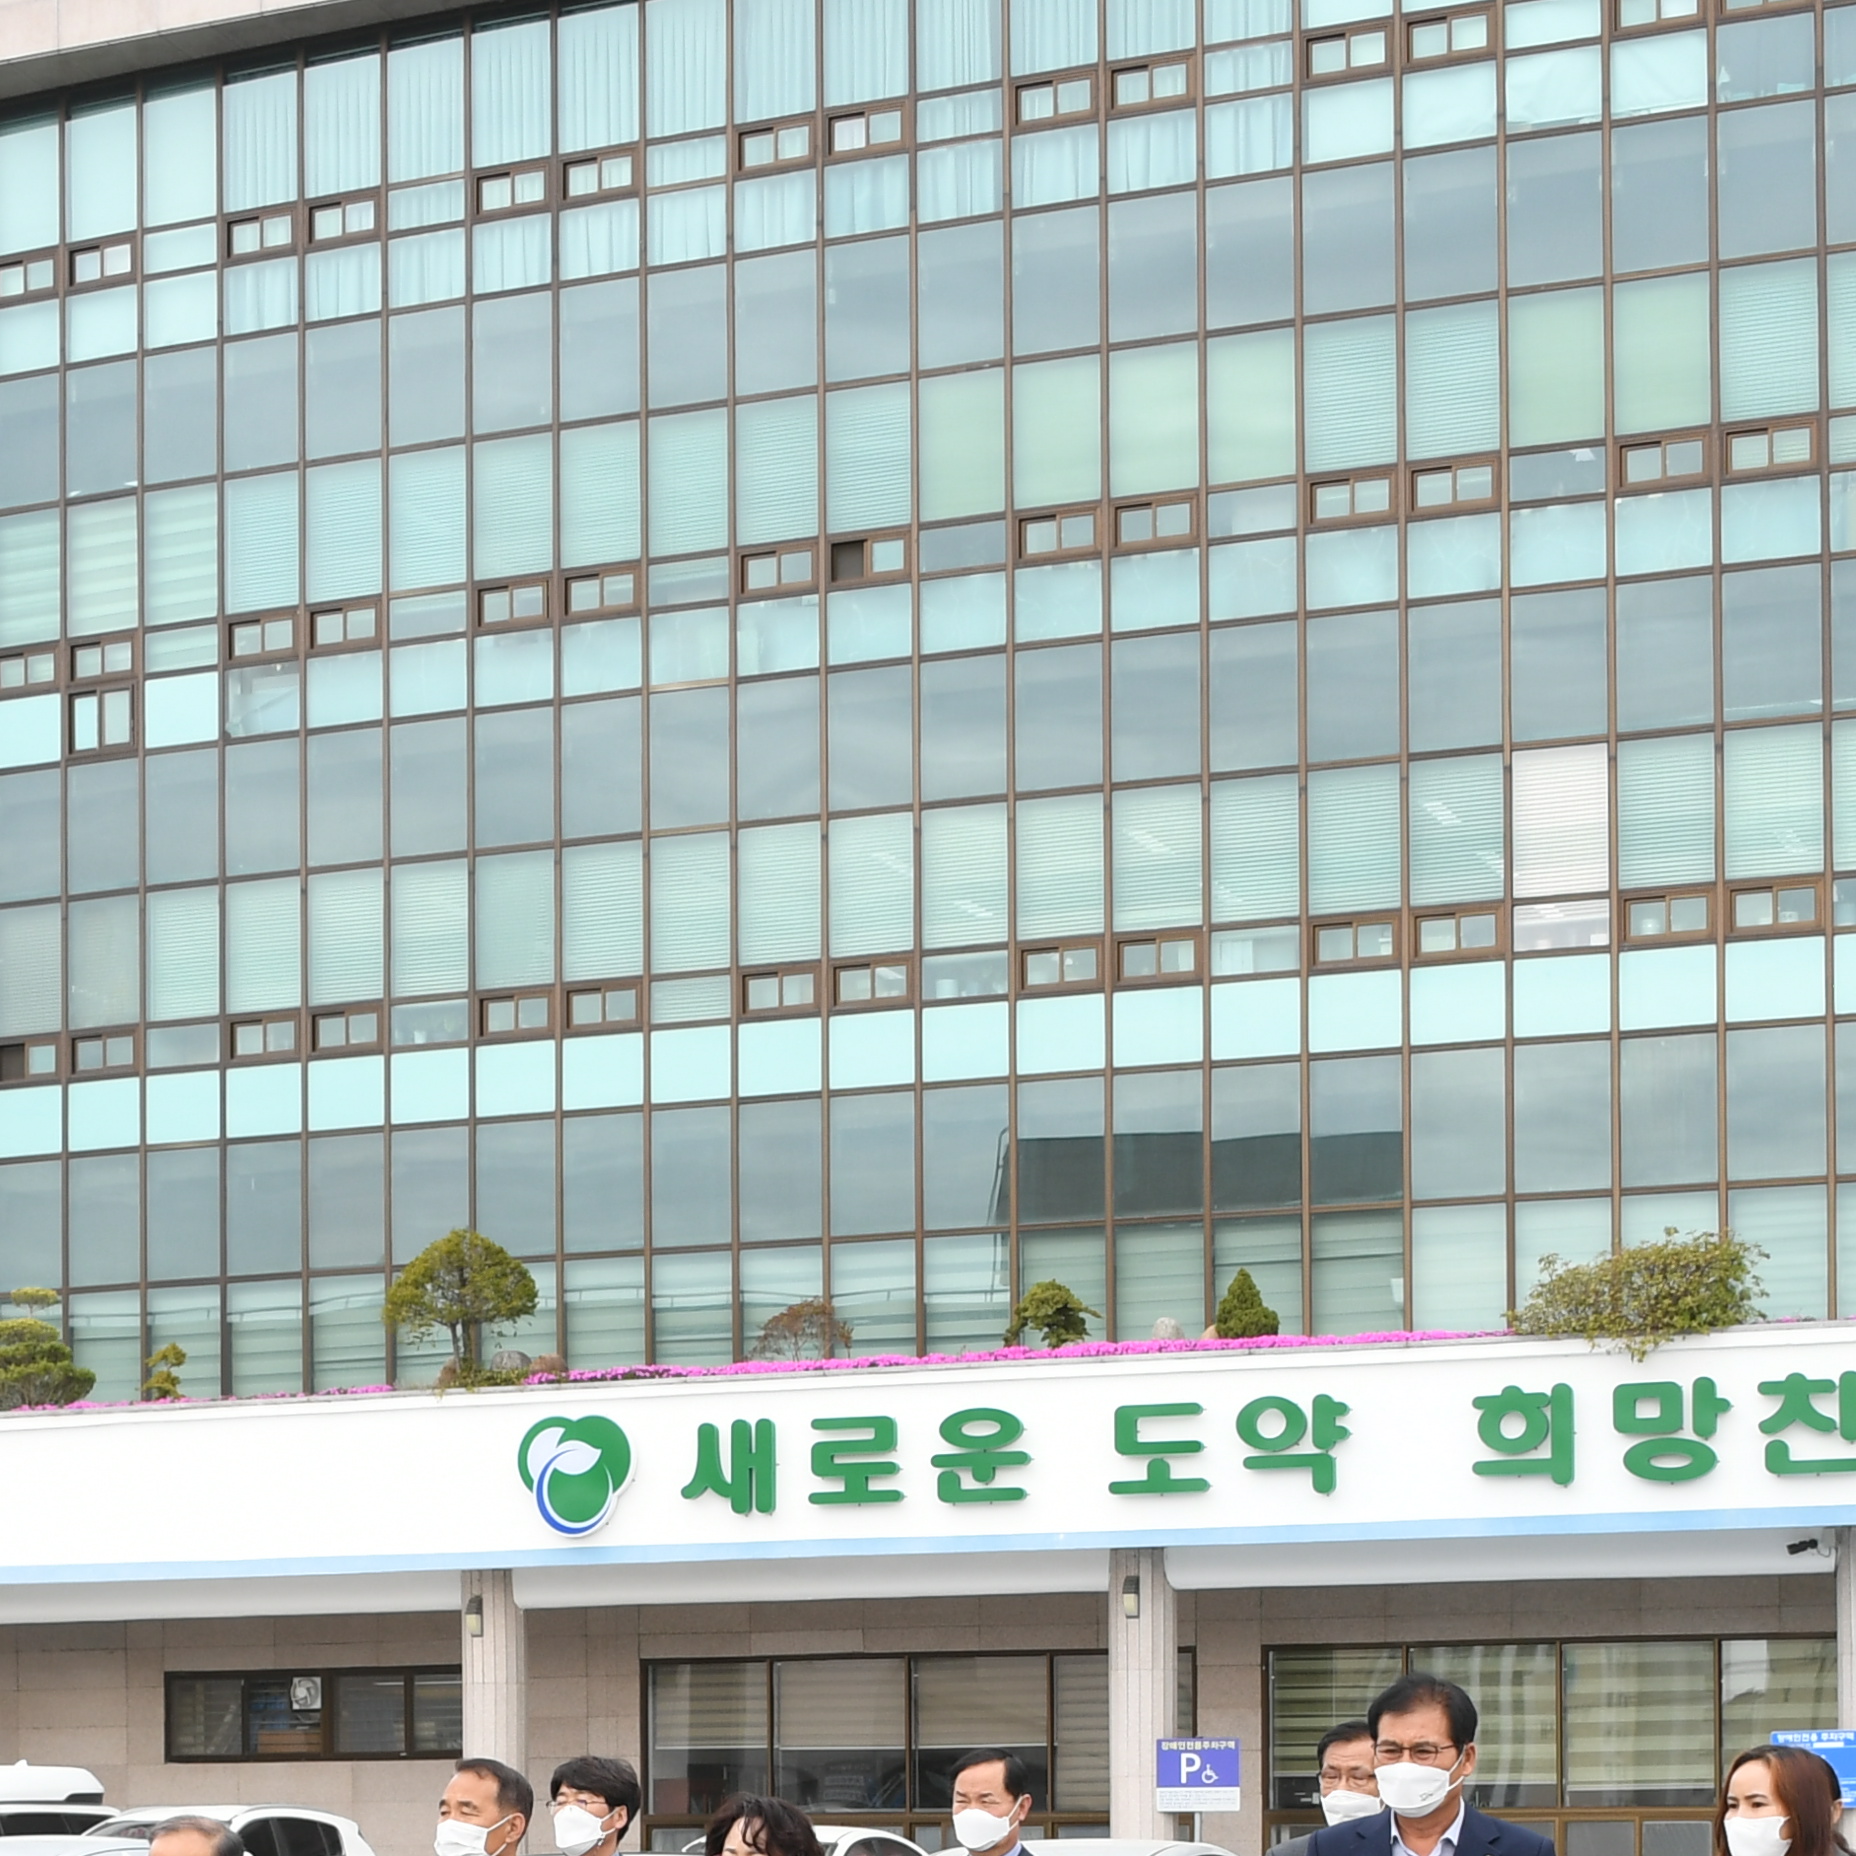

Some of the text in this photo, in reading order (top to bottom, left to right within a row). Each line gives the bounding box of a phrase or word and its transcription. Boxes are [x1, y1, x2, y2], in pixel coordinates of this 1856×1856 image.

[683, 1407, 1031, 1514] 새로운
[1110, 1394, 1351, 1495] 도약
[1180, 1752, 1201, 1784] P
